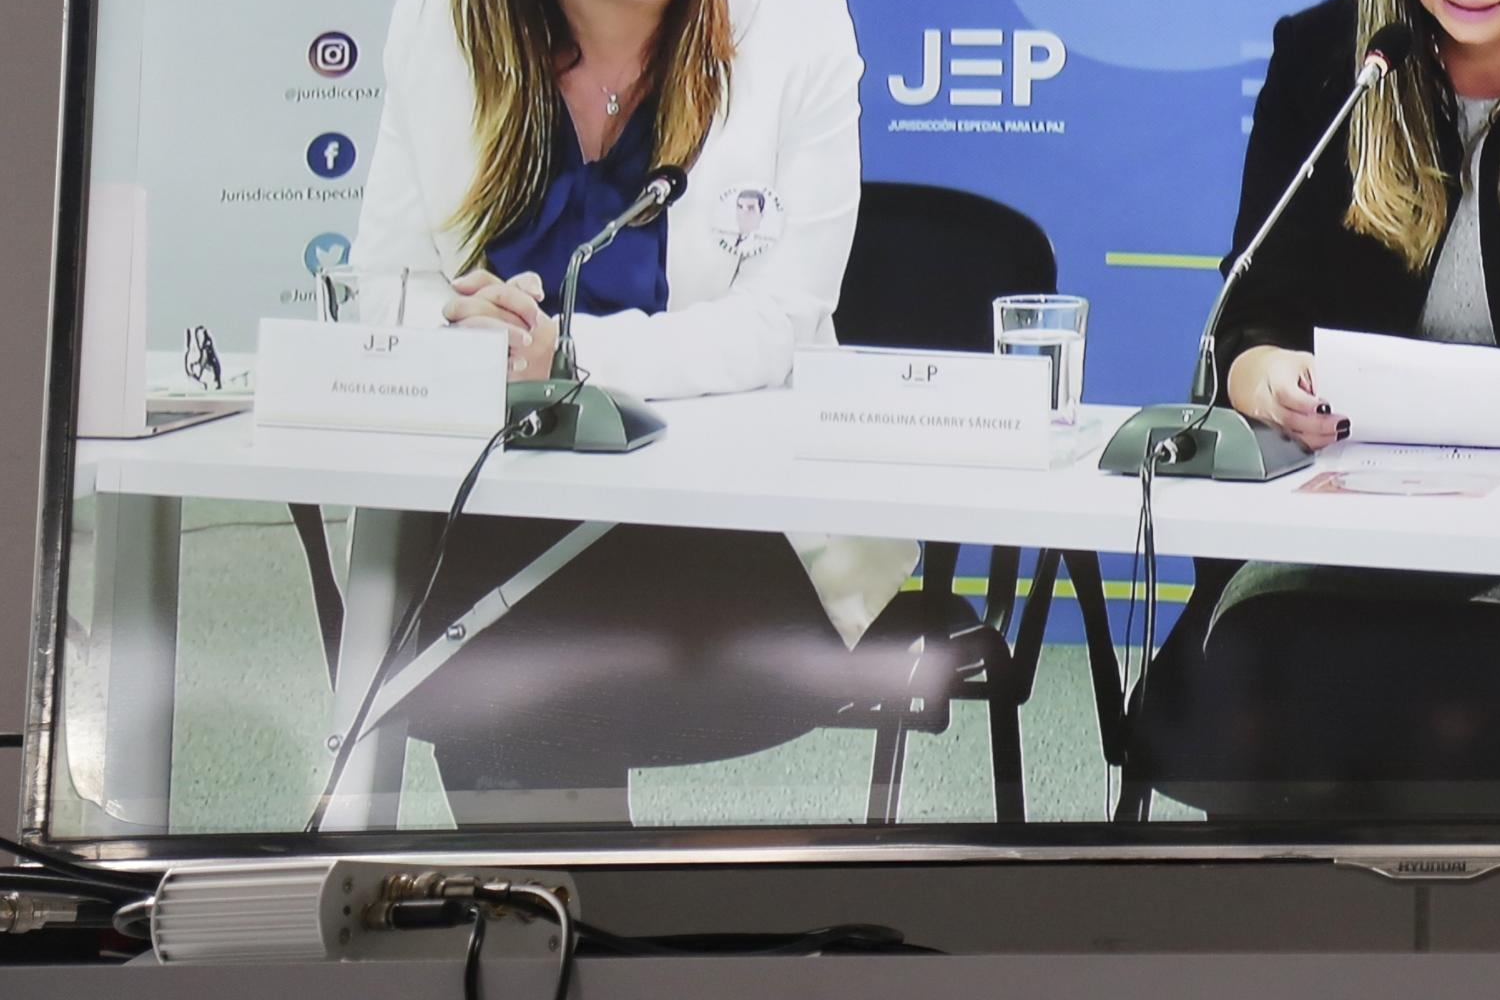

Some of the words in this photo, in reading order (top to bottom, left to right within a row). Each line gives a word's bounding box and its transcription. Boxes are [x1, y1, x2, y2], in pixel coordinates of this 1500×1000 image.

[887, 29, 1067, 106] JEP
[958, 119, 1003, 132] ESPECIAL
[1004, 120, 1031, 133] PARA
[1031, 120, 1046, 133] LA
[1046, 120, 1066, 133] PAZ
[221, 187, 303, 203] Jurisdicción
[307, 186, 364, 203] Especial
[331, 379, 375, 395] ÁNGELA
[379, 382, 429, 397] GIRALDO
[820, 410, 856, 424] DIANA
[859, 412, 916, 426] CAROLINA
[968, 414, 1022, 431] SÁNCHEZ
[1398, 860, 1467, 873] HYUNDAI
